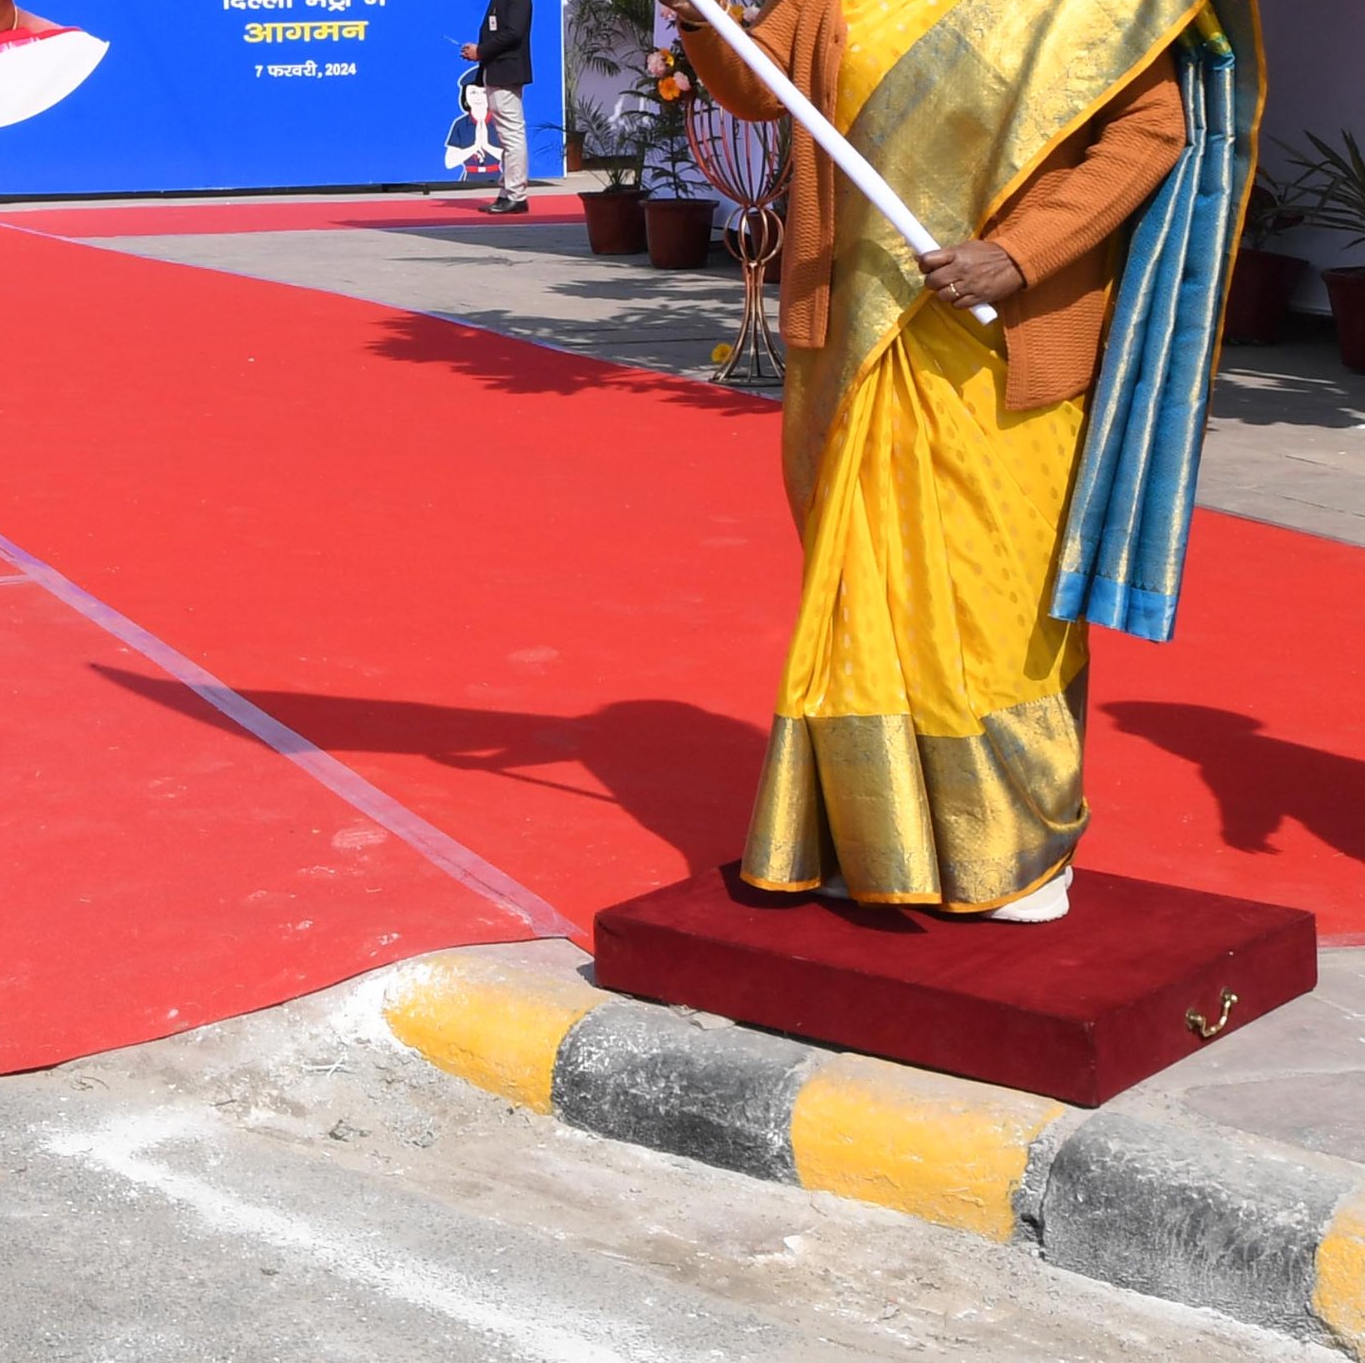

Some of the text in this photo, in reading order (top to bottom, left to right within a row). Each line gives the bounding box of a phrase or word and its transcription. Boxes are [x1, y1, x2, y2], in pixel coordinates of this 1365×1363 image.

[243, 20, 369, 45] आगमन
[255, 61, 357, 80] 7 फरवरी, 2024
